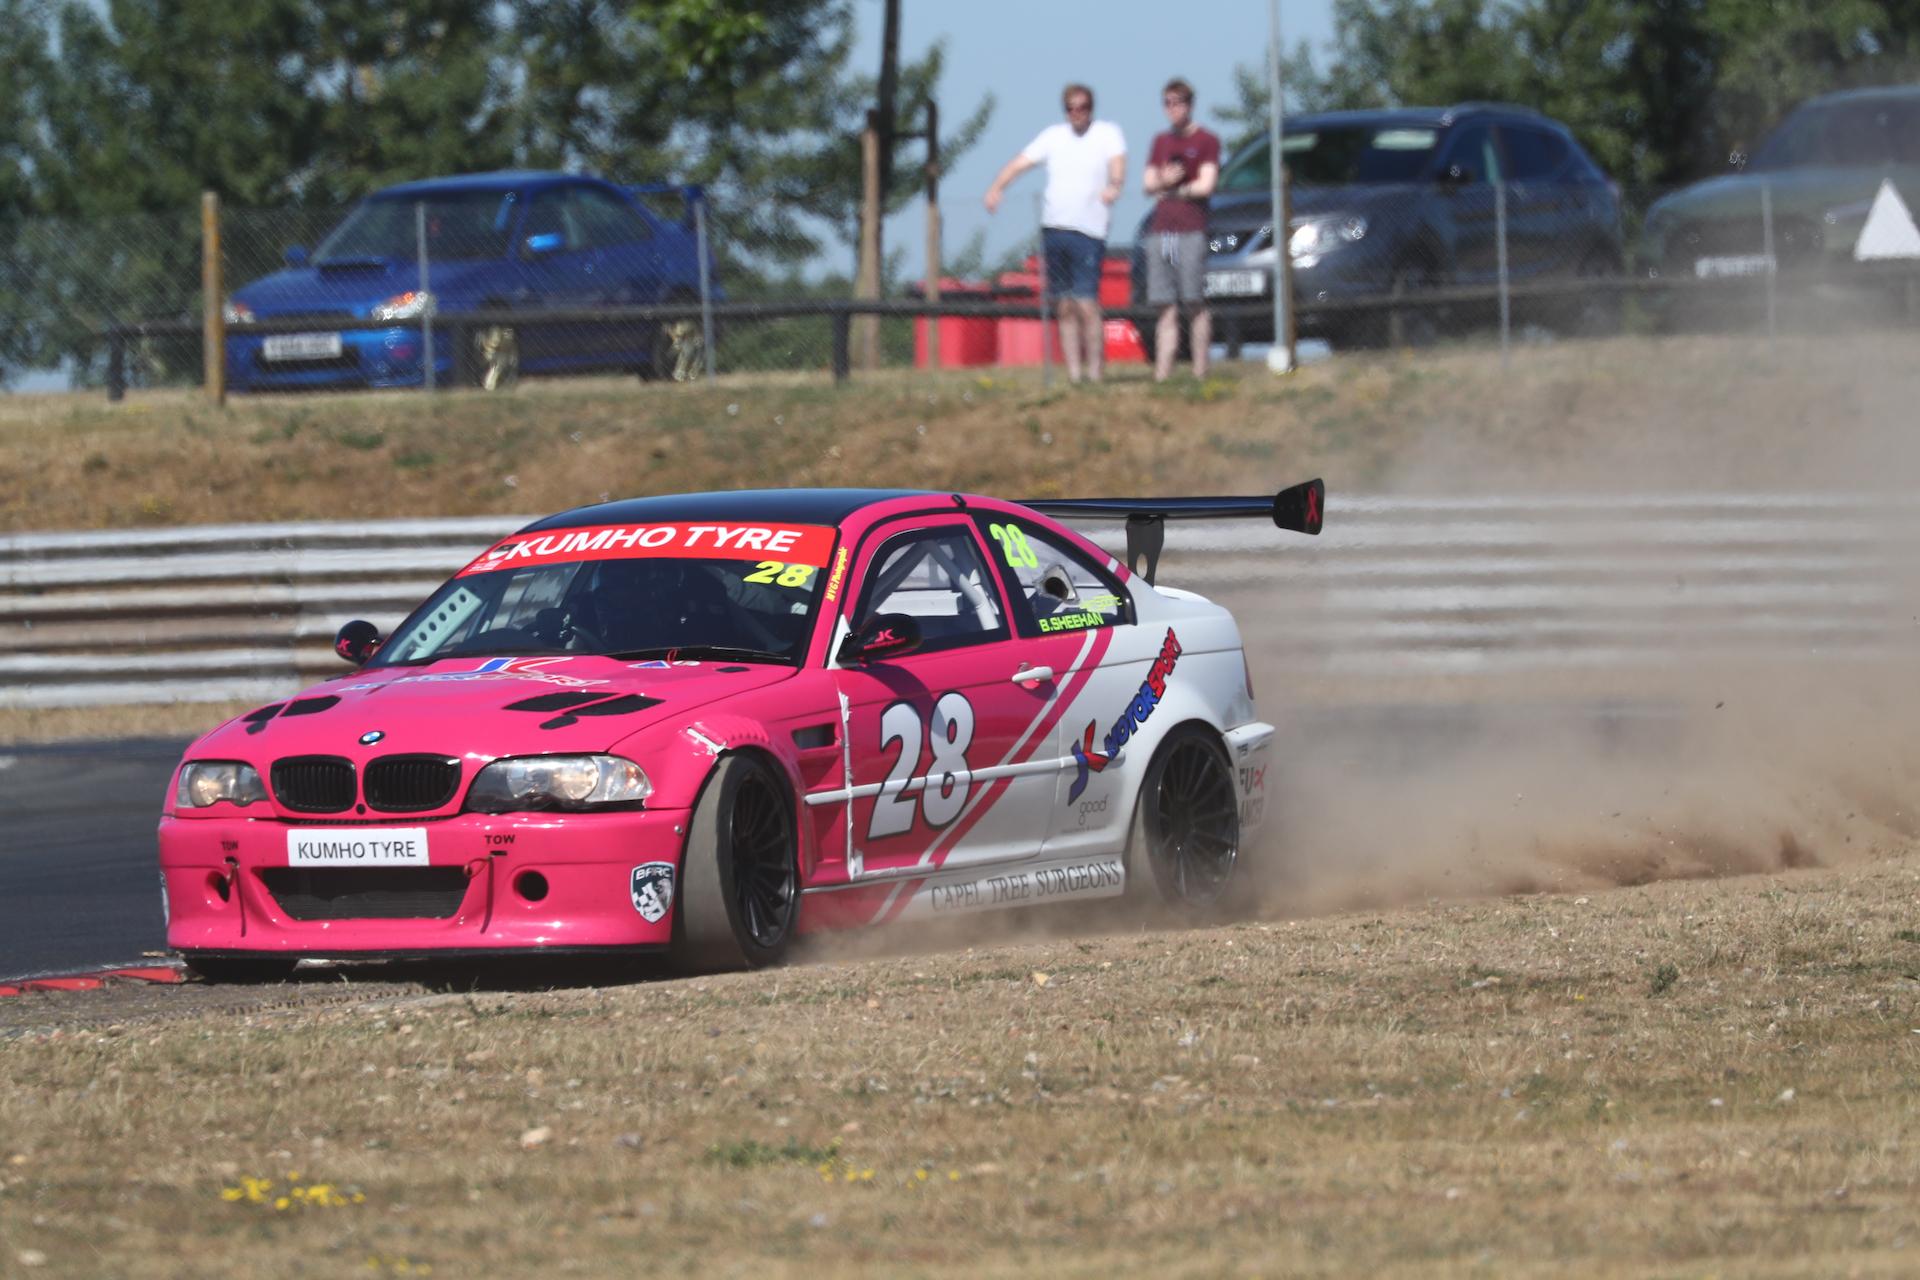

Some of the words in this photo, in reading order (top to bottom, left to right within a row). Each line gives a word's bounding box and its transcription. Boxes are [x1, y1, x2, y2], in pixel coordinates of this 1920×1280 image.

[505, 526, 677, 560] KUMHO
[683, 526, 803, 553] TYRE
[989, 523, 1039, 569] 28
[743, 560, 814, 588] 28
[1038, 612, 1104, 633] B.SHEEHAN
[866, 689, 976, 841] 28
[297, 842, 365, 860] KUMHO
[371, 841, 416, 859] TYRE
[484, 834, 516, 846] TOW
[987, 874, 1031, 904] TREE
[1036, 861, 1121, 897] SURGEONS
